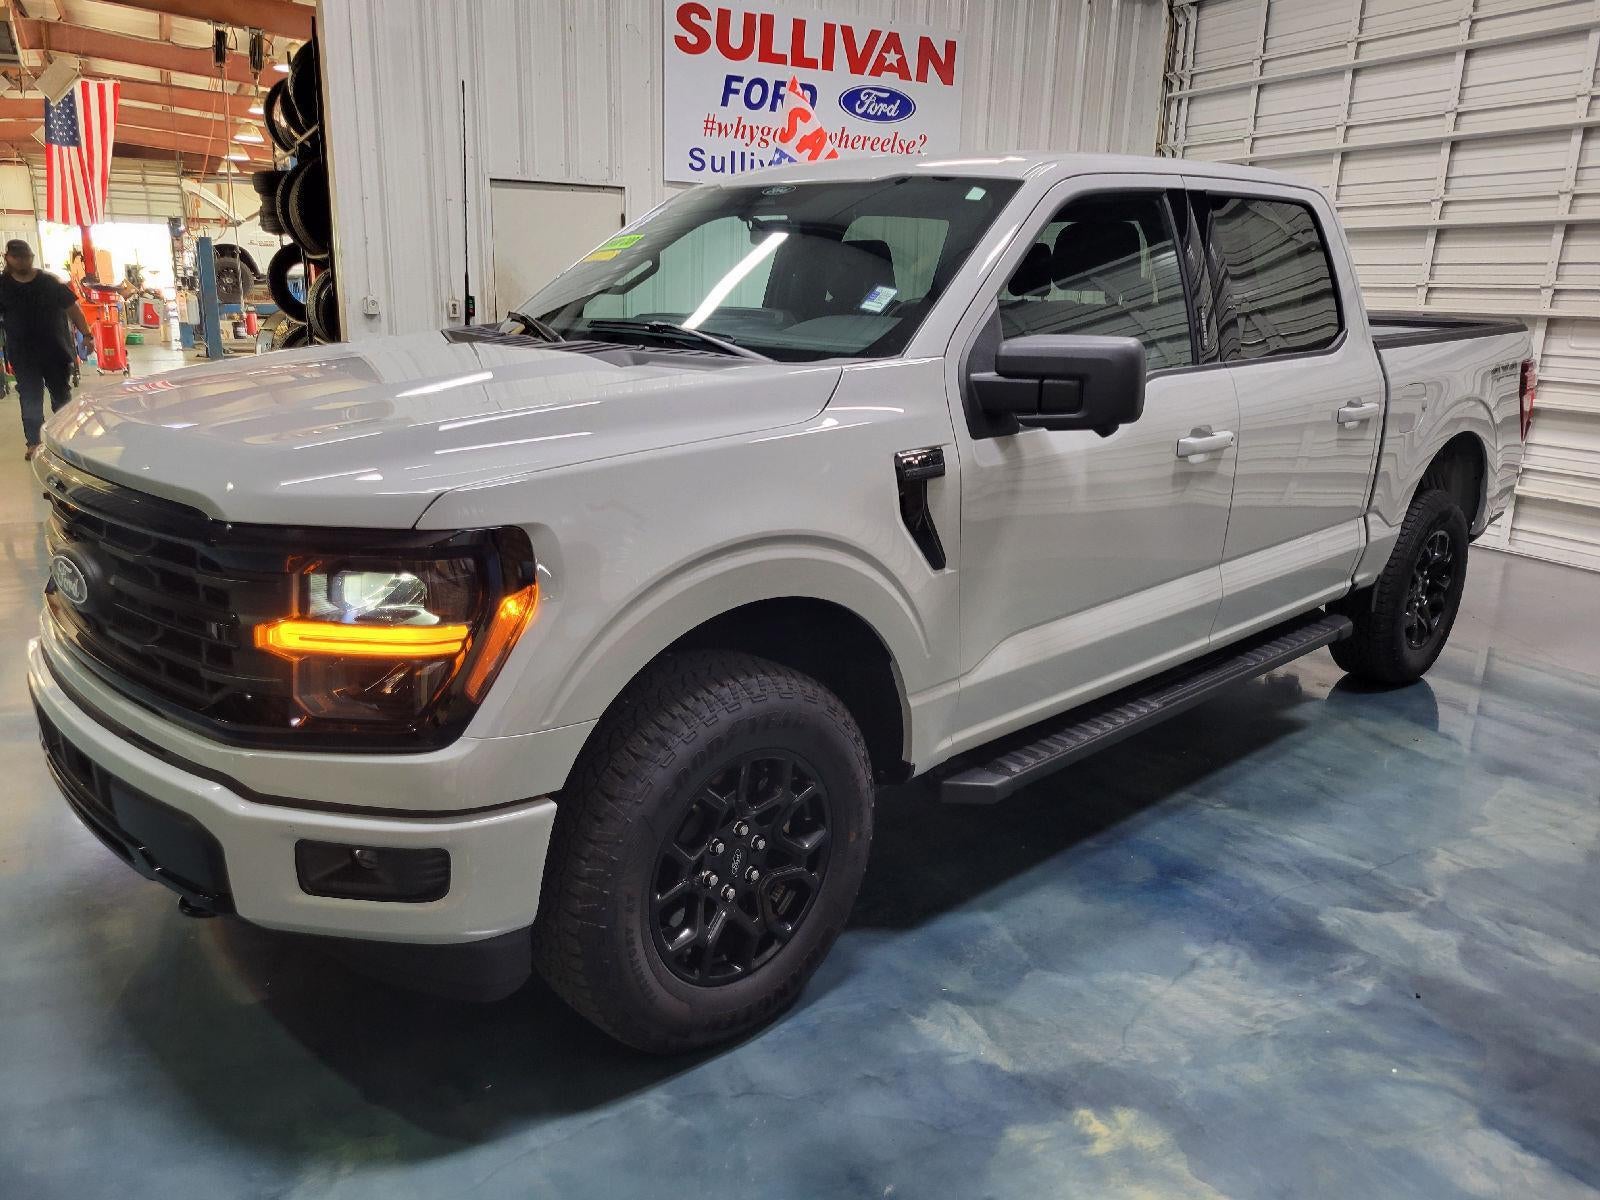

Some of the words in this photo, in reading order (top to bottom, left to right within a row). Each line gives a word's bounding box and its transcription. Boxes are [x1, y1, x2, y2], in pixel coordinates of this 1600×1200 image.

[673, 2, 957, 86] SULLIVAN
[855, 89, 900, 118] Ford
[53, 560, 80, 598] Ford
